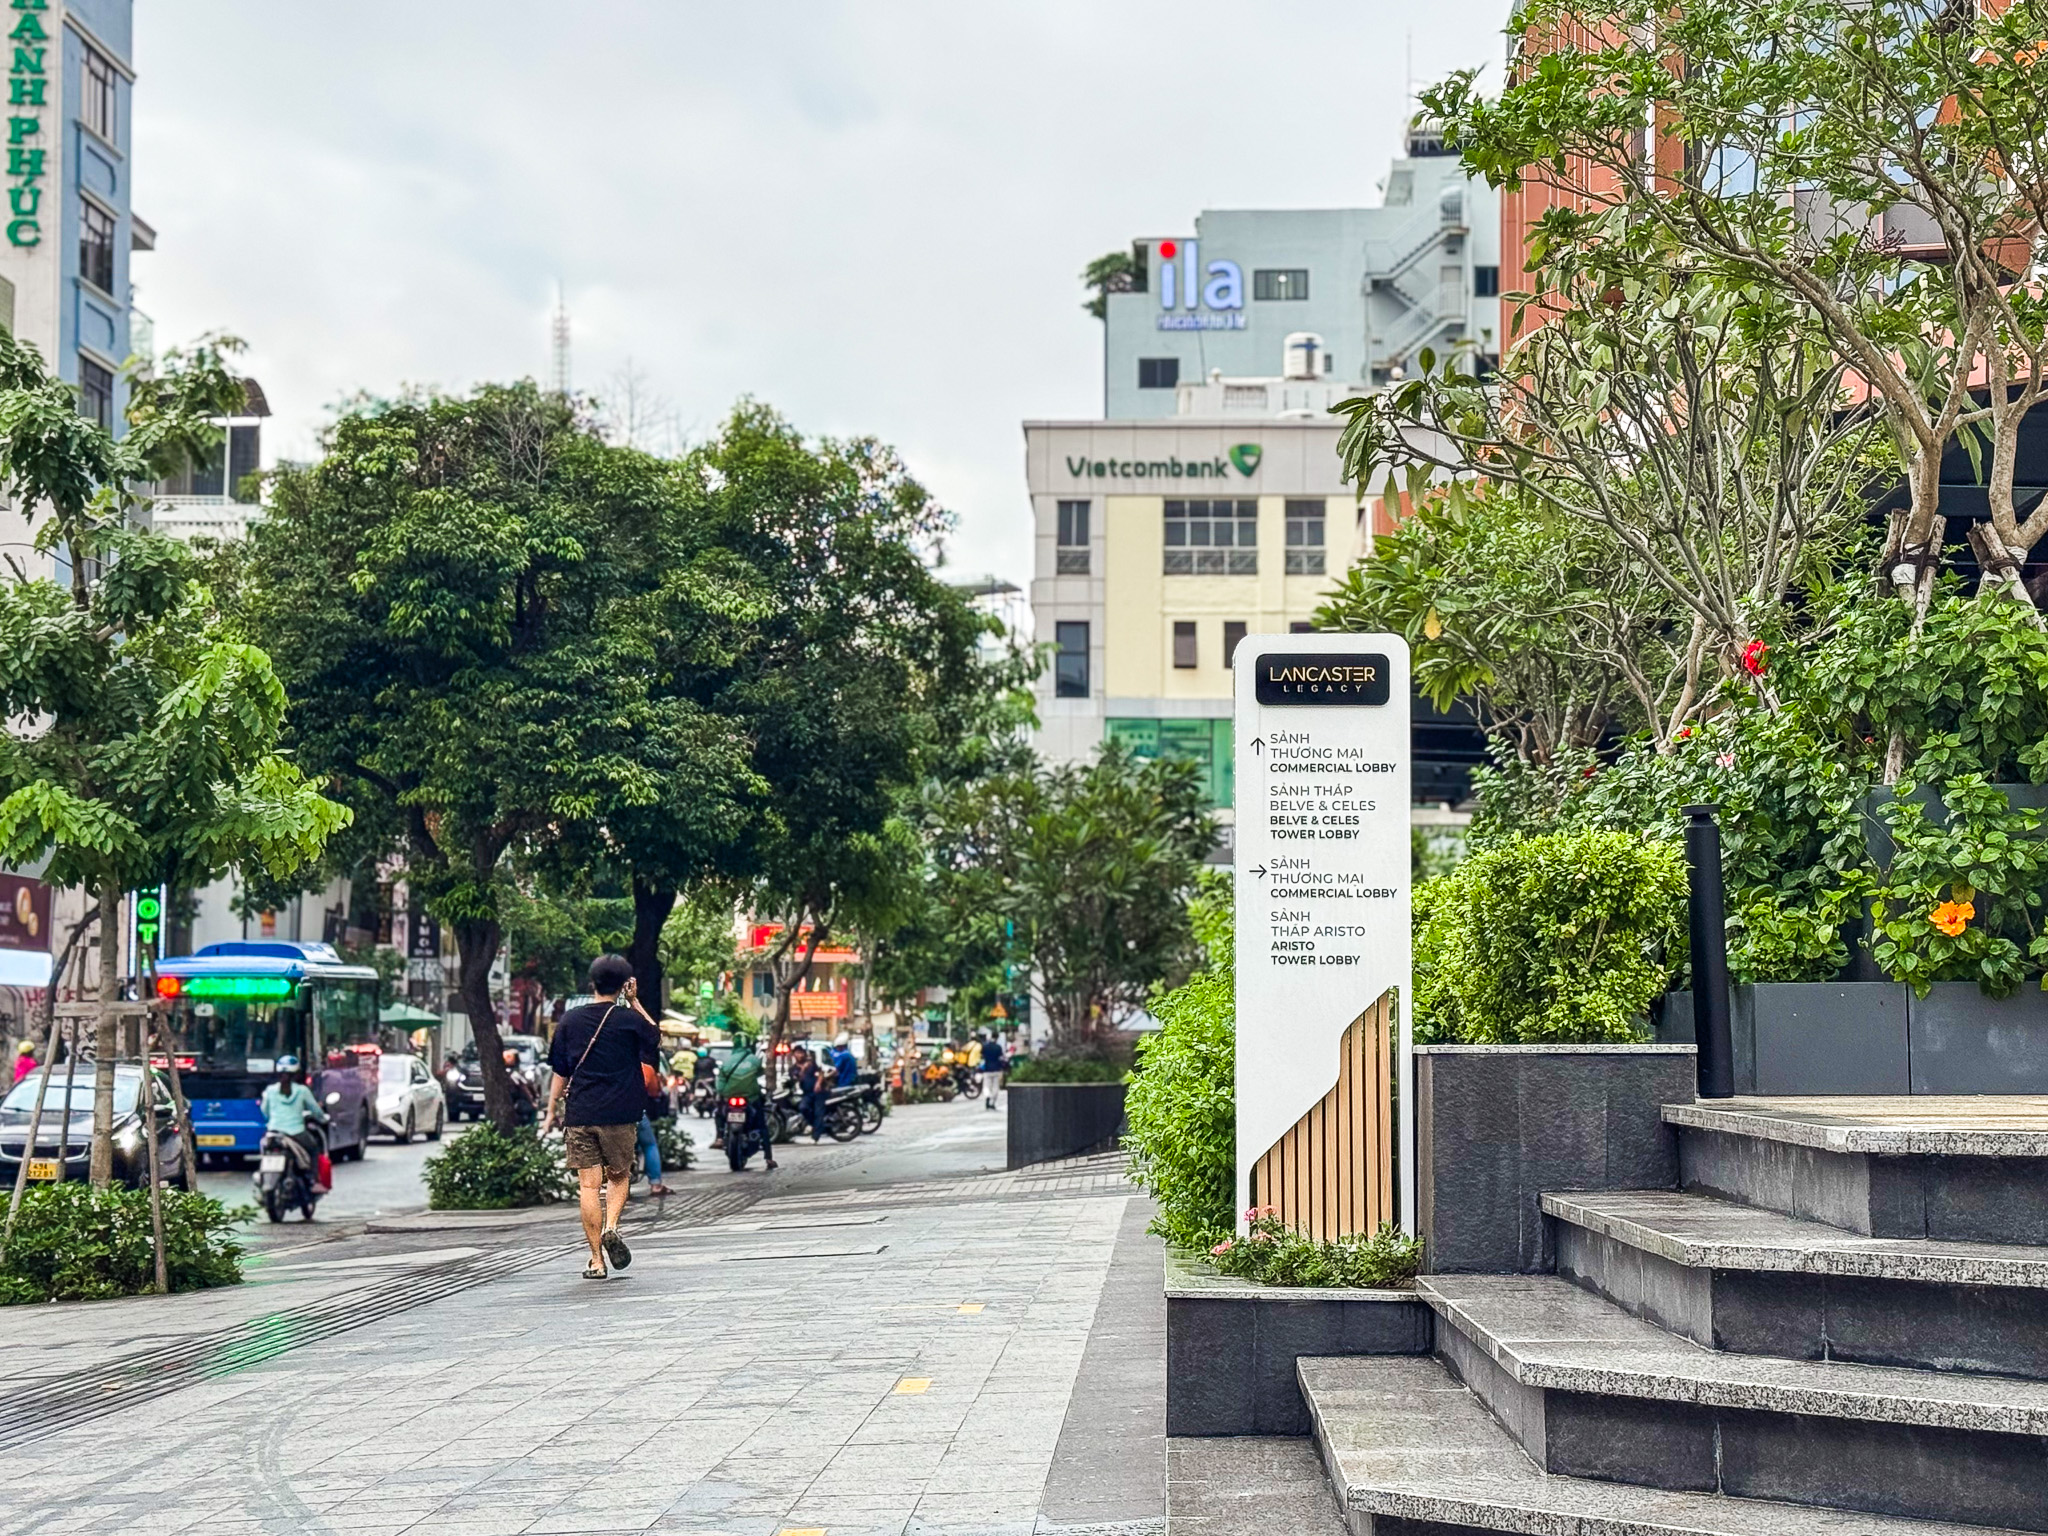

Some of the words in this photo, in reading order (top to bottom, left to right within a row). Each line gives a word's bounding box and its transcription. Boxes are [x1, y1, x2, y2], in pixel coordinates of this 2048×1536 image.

[6, 116, 47, 248] PHÚC
[1159, 239, 1245, 311] ila
[1066, 455, 1229, 479] Vietcombank
[1269, 666, 1376, 682] LANCASTER
[1283, 684, 1362, 693] LEGACY
[1270, 729, 1310, 744] SẢNH
[1270, 746, 1333, 759] THƯƠNG
[1337, 747, 1364, 762] MẠI
[1270, 762, 1353, 773] COMMERCIAL
[1355, 762, 1397, 773] LOBBY
[1270, 781, 1310, 797] SẢNH
[1314, 780, 1353, 797] THÁP
[1270, 800, 1315, 811] BELVE
[1318, 800, 1328, 811] &
[1331, 800, 1376, 811] CELES
[1270, 815, 1308, 826] BELVE
[1310, 815, 1319, 826] &
[1322, 815, 1360, 826] CELES
[1270, 829, 1316, 840] TOWER
[1318, 829, 1360, 840] LOBBY
[1270, 855, 1310, 870] SẢNH
[1270, 872, 1333, 884] THƯƠNG
[1337, 873, 1364, 887] MẠI
[1270, 888, 1353, 899] COMMERCIAL
[1356, 888, 1398, 899] LOBBY
[1270, 907, 1311, 922] SẢNH
[1270, 923, 1310, 937] THÁP
[1313, 925, 1366, 937] ARISTO
[1270, 940, 1316, 951] ARISTO
[1270, 955, 1316, 966] TOWER
[1319, 955, 1361, 966] LOBBY
